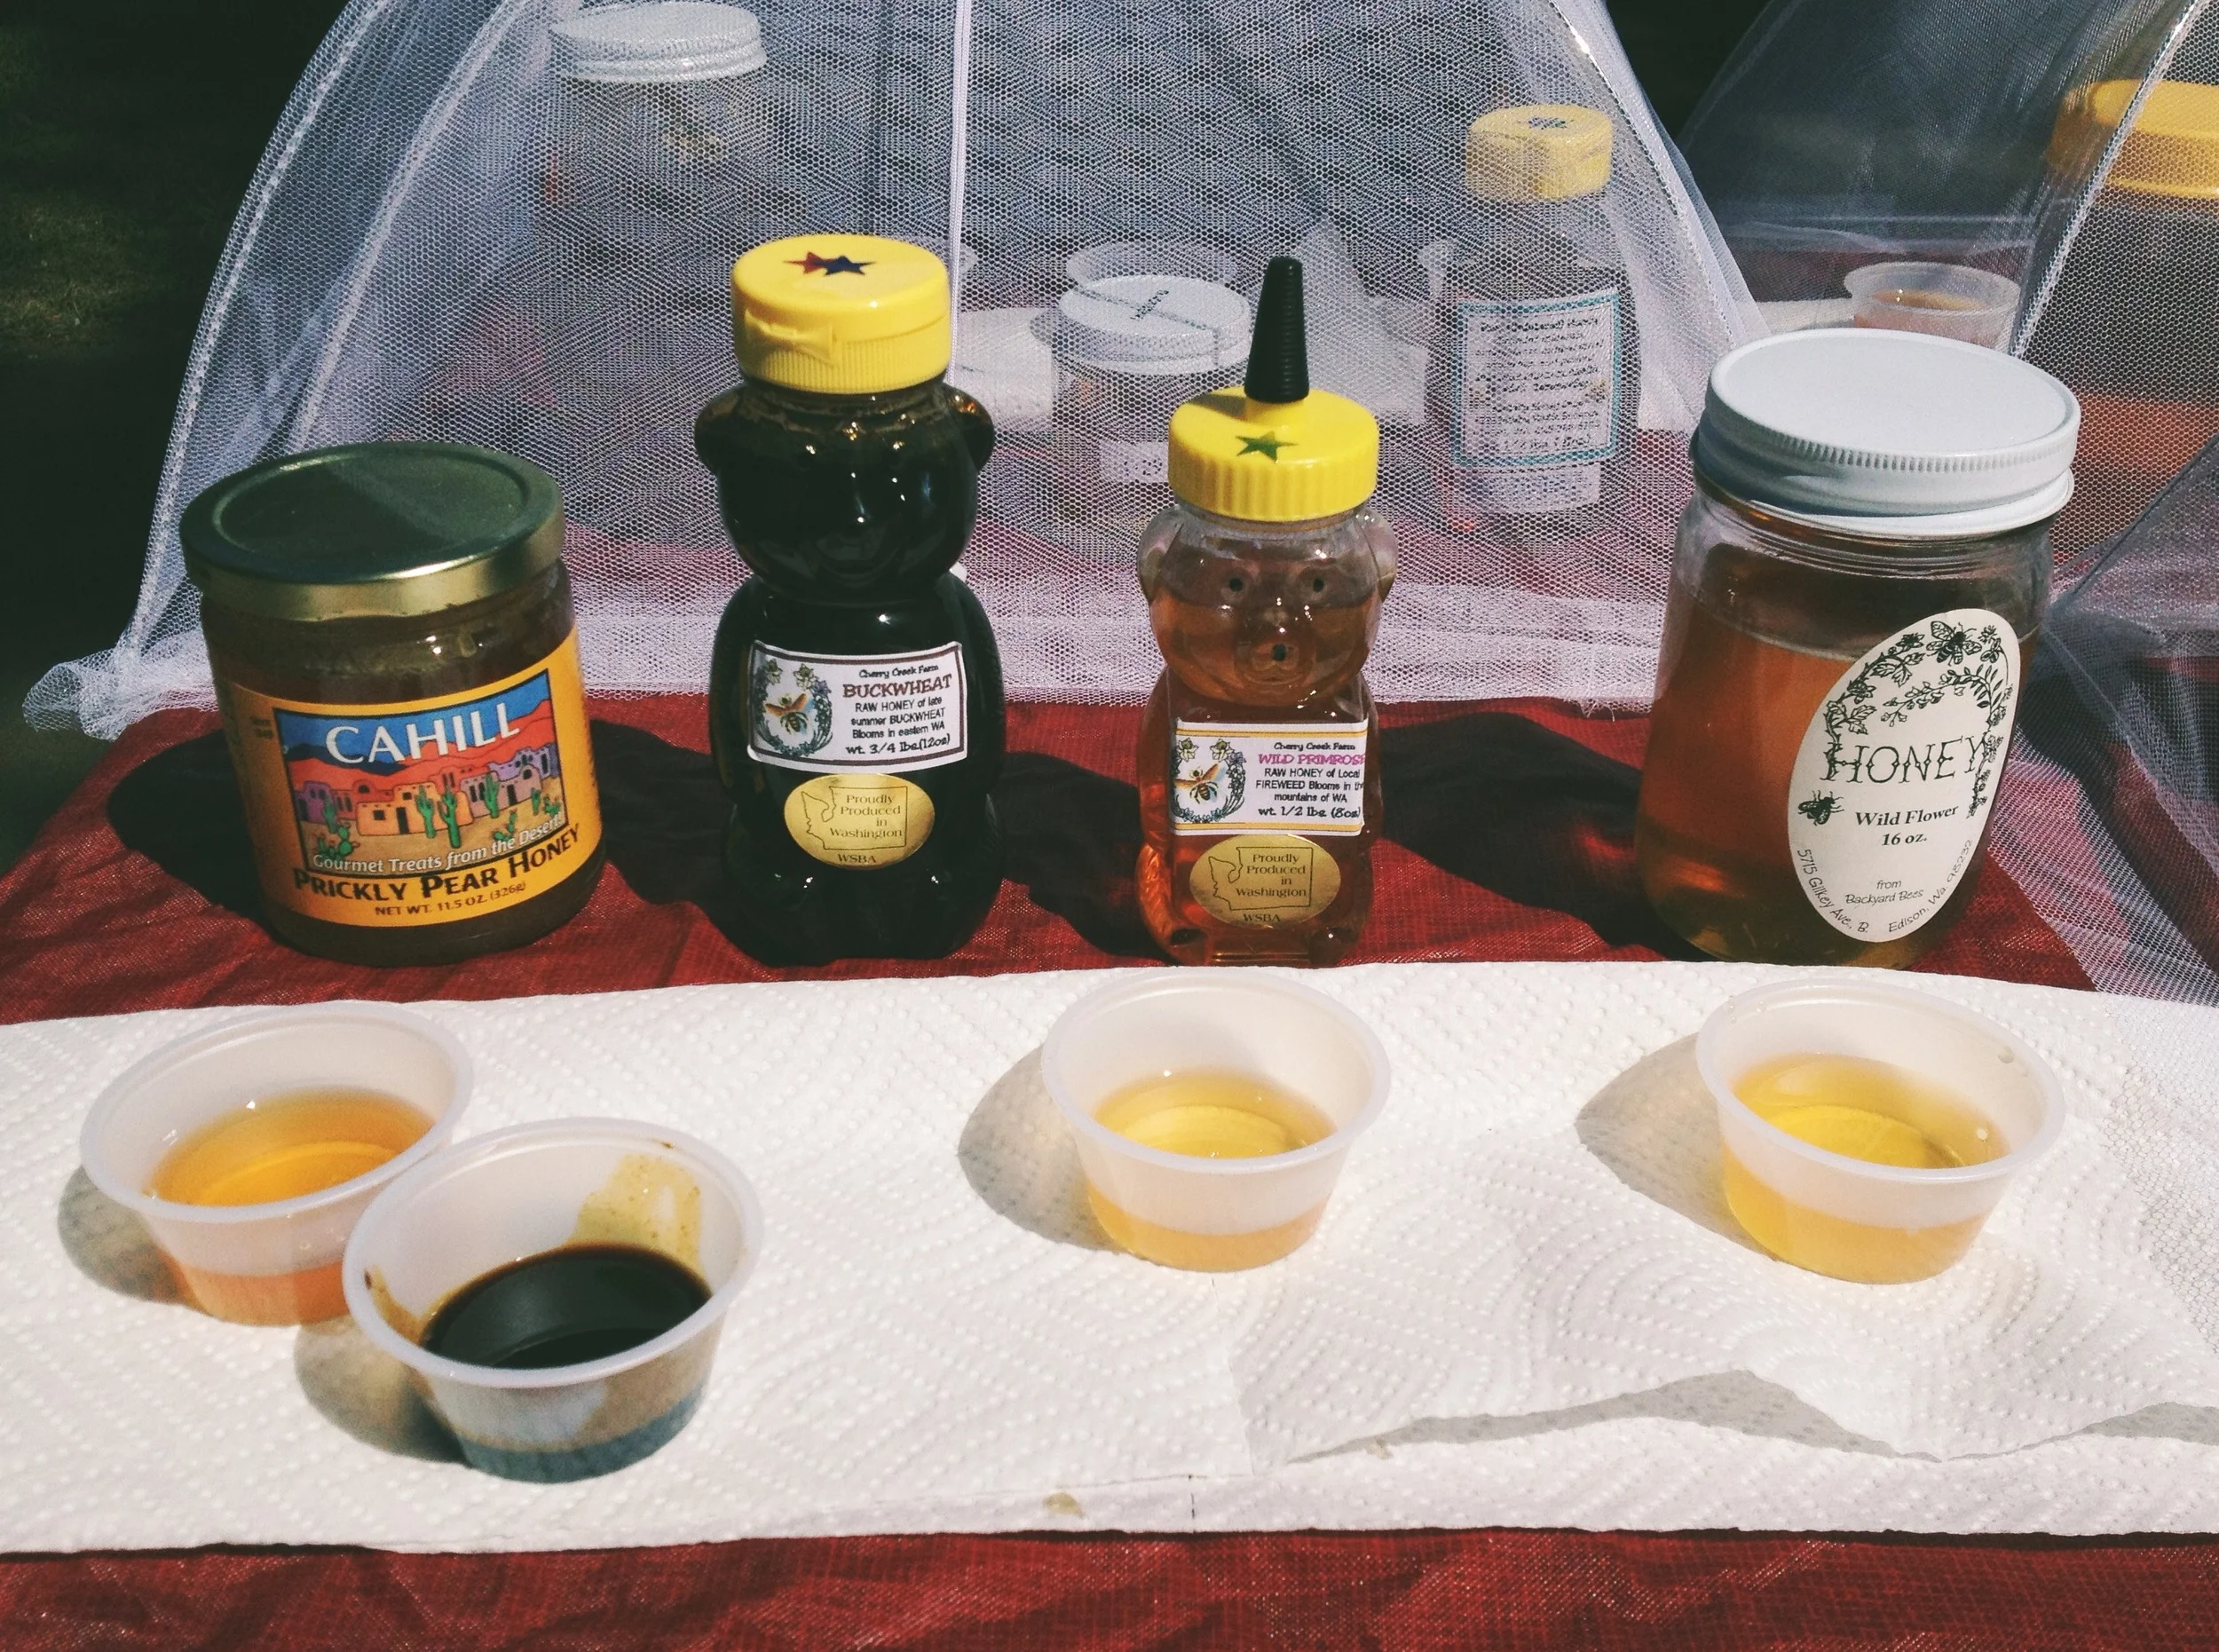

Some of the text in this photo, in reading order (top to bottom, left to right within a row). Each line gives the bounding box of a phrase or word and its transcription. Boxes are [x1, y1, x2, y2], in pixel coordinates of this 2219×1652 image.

[859, 669, 889, 679] Cherry
[892, 667, 917, 676] Creek
[842, 674, 952, 698] BUCKWHEAT
[856, 696, 942, 712] RAW HONEY of late
[850, 707, 945, 726] summer BUCKWHEAT
[326, 702, 520, 764] CAHILL
[852, 721, 945, 739] Blooms in eastern WA
[870, 742, 896, 754] 3/4
[1274, 742, 1303, 751] Cherry
[1258, 754, 1294, 764] WILD
[1820, 732, 1986, 783] HONEY
[1264, 768, 1361, 778] RAW HONEY of Local
[1255, 780, 1305, 789] FIREWEED
[1308, 780, 1340, 790] Blooms
[1344, 781, 1351, 791] in
[846, 794, 895, 804] Proudly
[1274, 792, 1348, 803] mountains of WA
[841, 805, 901, 815] Produced
[1281, 806, 1303, 816] 1/2
[1855, 806, 1959, 826] Wild Flower
[876, 818, 888, 826] in
[829, 827, 903, 839] Washington
[1881, 832, 1928, 846] 16 oz.
[312, 854, 384, 873] Gourmet
[388, 856, 442, 873] Treats
[445, 846, 487, 870] from
[491, 839, 516, 855] the
[837, 853, 877, 863] WSBA
[1252, 853, 1299, 864] Proudly
[293, 823, 580, 901] PRICKLY PEAR HONEY
[1246, 865, 1306, 874] Produced
[1281, 876, 1292, 885] in
[1797, 849, 1818, 874] 5715
[1808, 877, 1835, 908] Gilkey
[1875, 880, 1901, 889] from
[375, 905, 401, 915] NET
[489, 881, 526, 901] (326g)
[1236, 888, 1307, 898] Washington
[1844, 889, 1924, 906] Backyard Bees
[1243, 913, 1281, 922] WSBA
